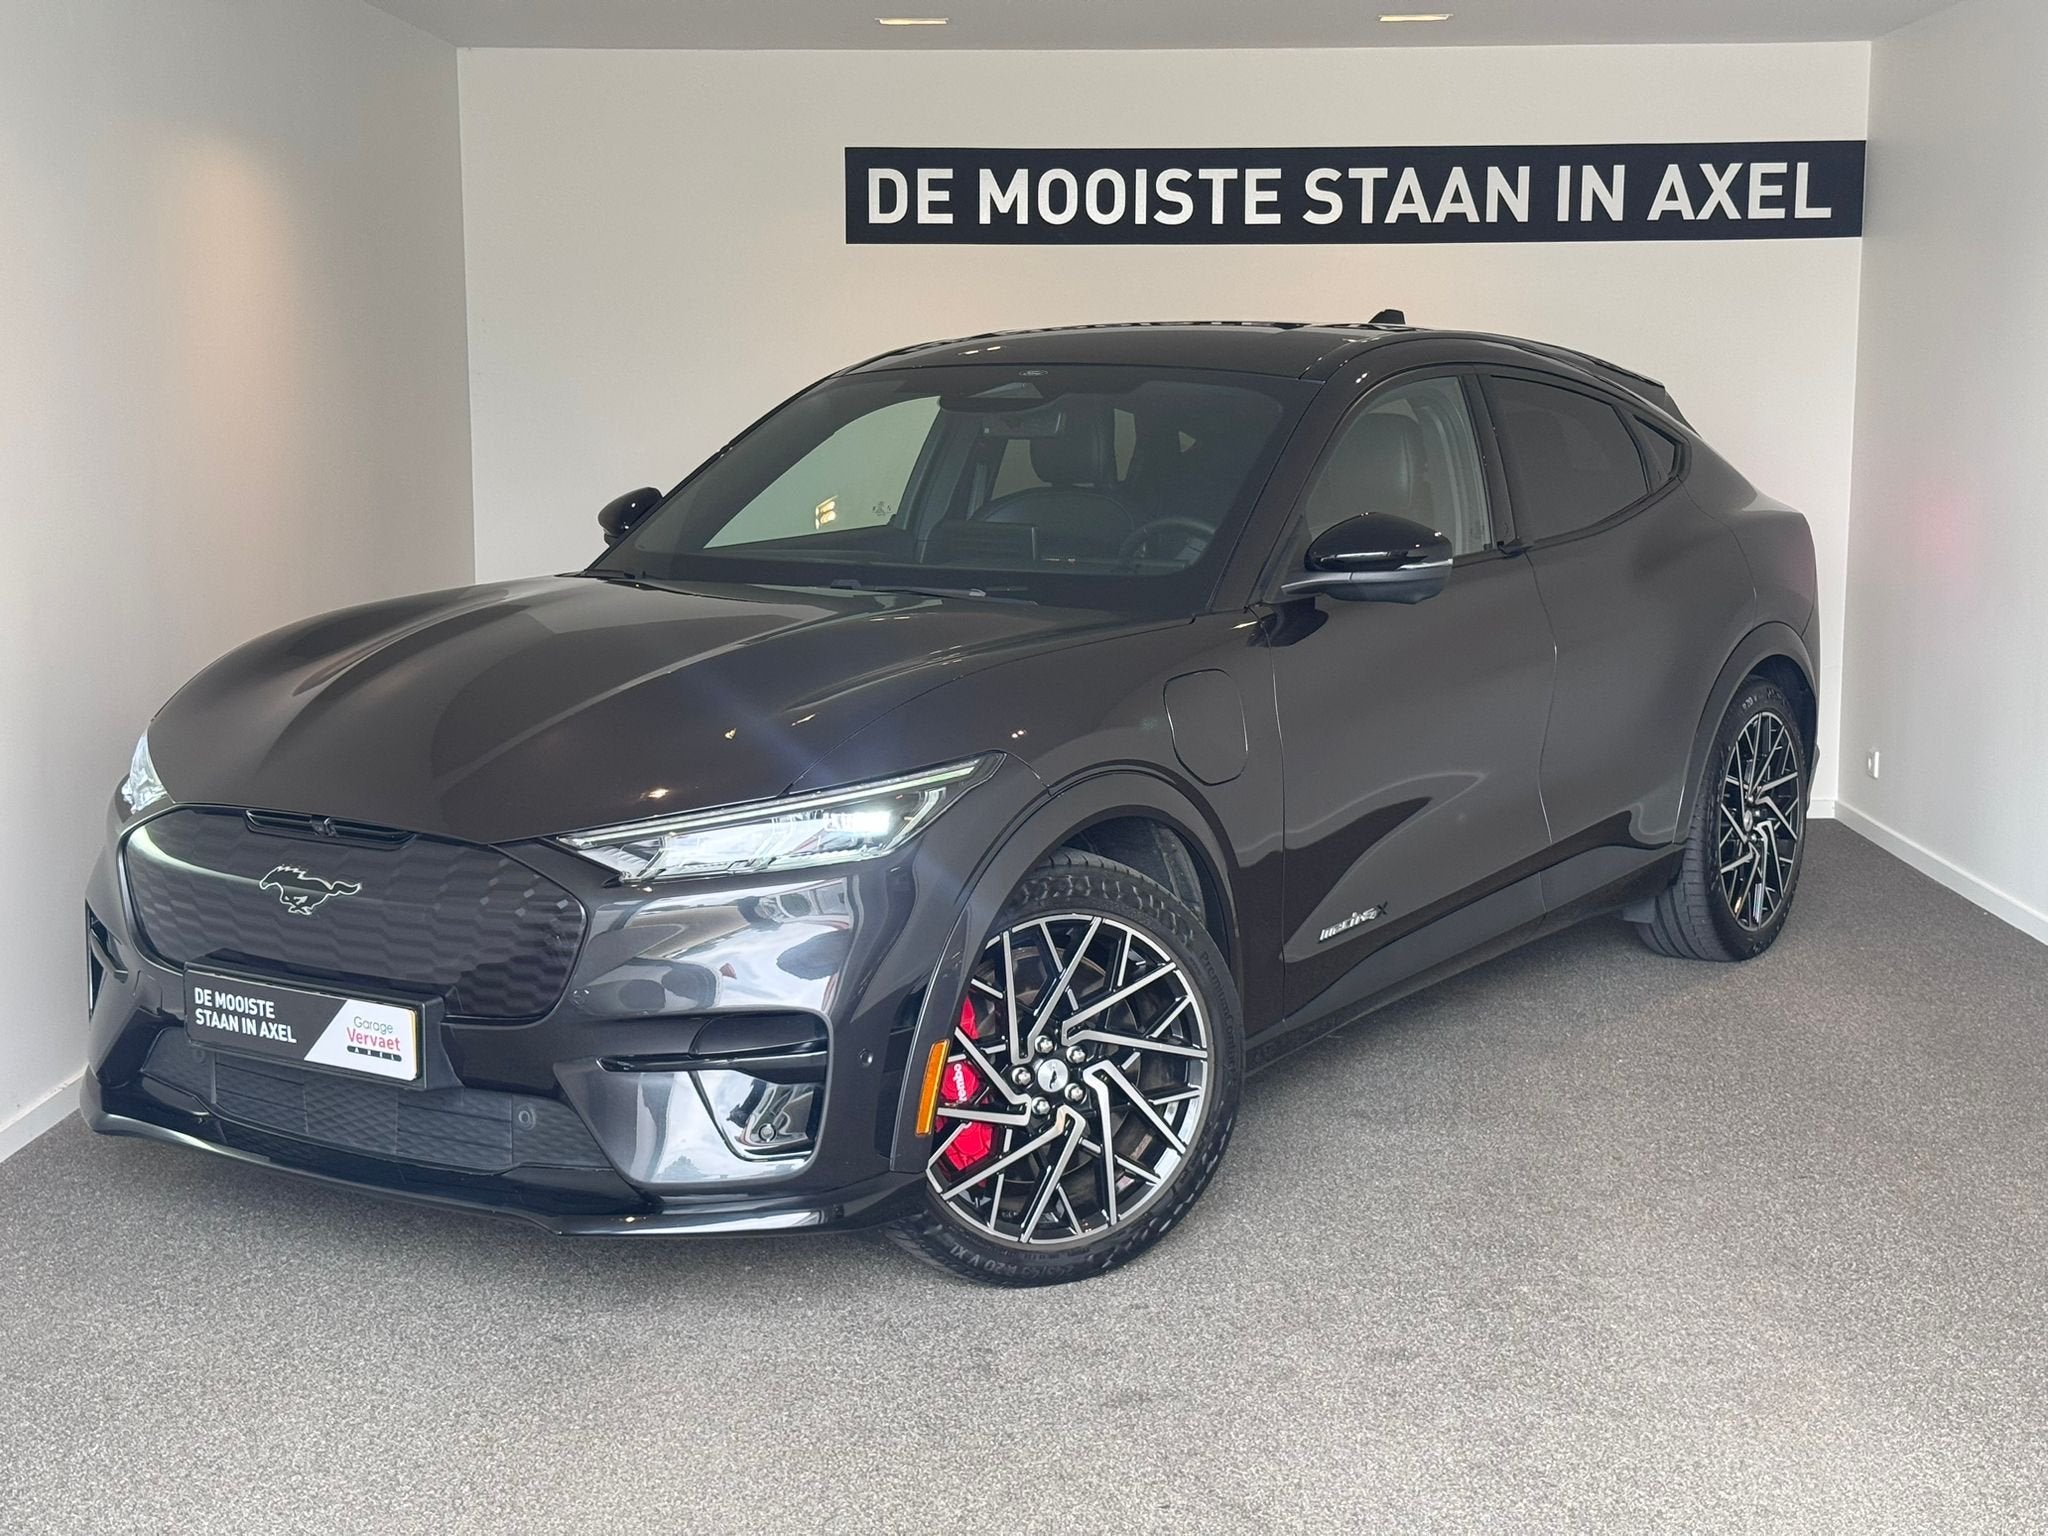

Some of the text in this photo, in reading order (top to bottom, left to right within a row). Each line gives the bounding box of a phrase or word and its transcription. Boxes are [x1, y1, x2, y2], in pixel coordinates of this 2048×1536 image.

[868, 161, 1832, 226] DE MOOISTE STAAN IN AXEL
[194, 987, 276, 1019] DE MOOISTE
[195, 1008, 297, 1044] STAAN IN AXEL
[346, 1026, 401, 1052] Vervaet
[353, 1015, 394, 1035] Garage
